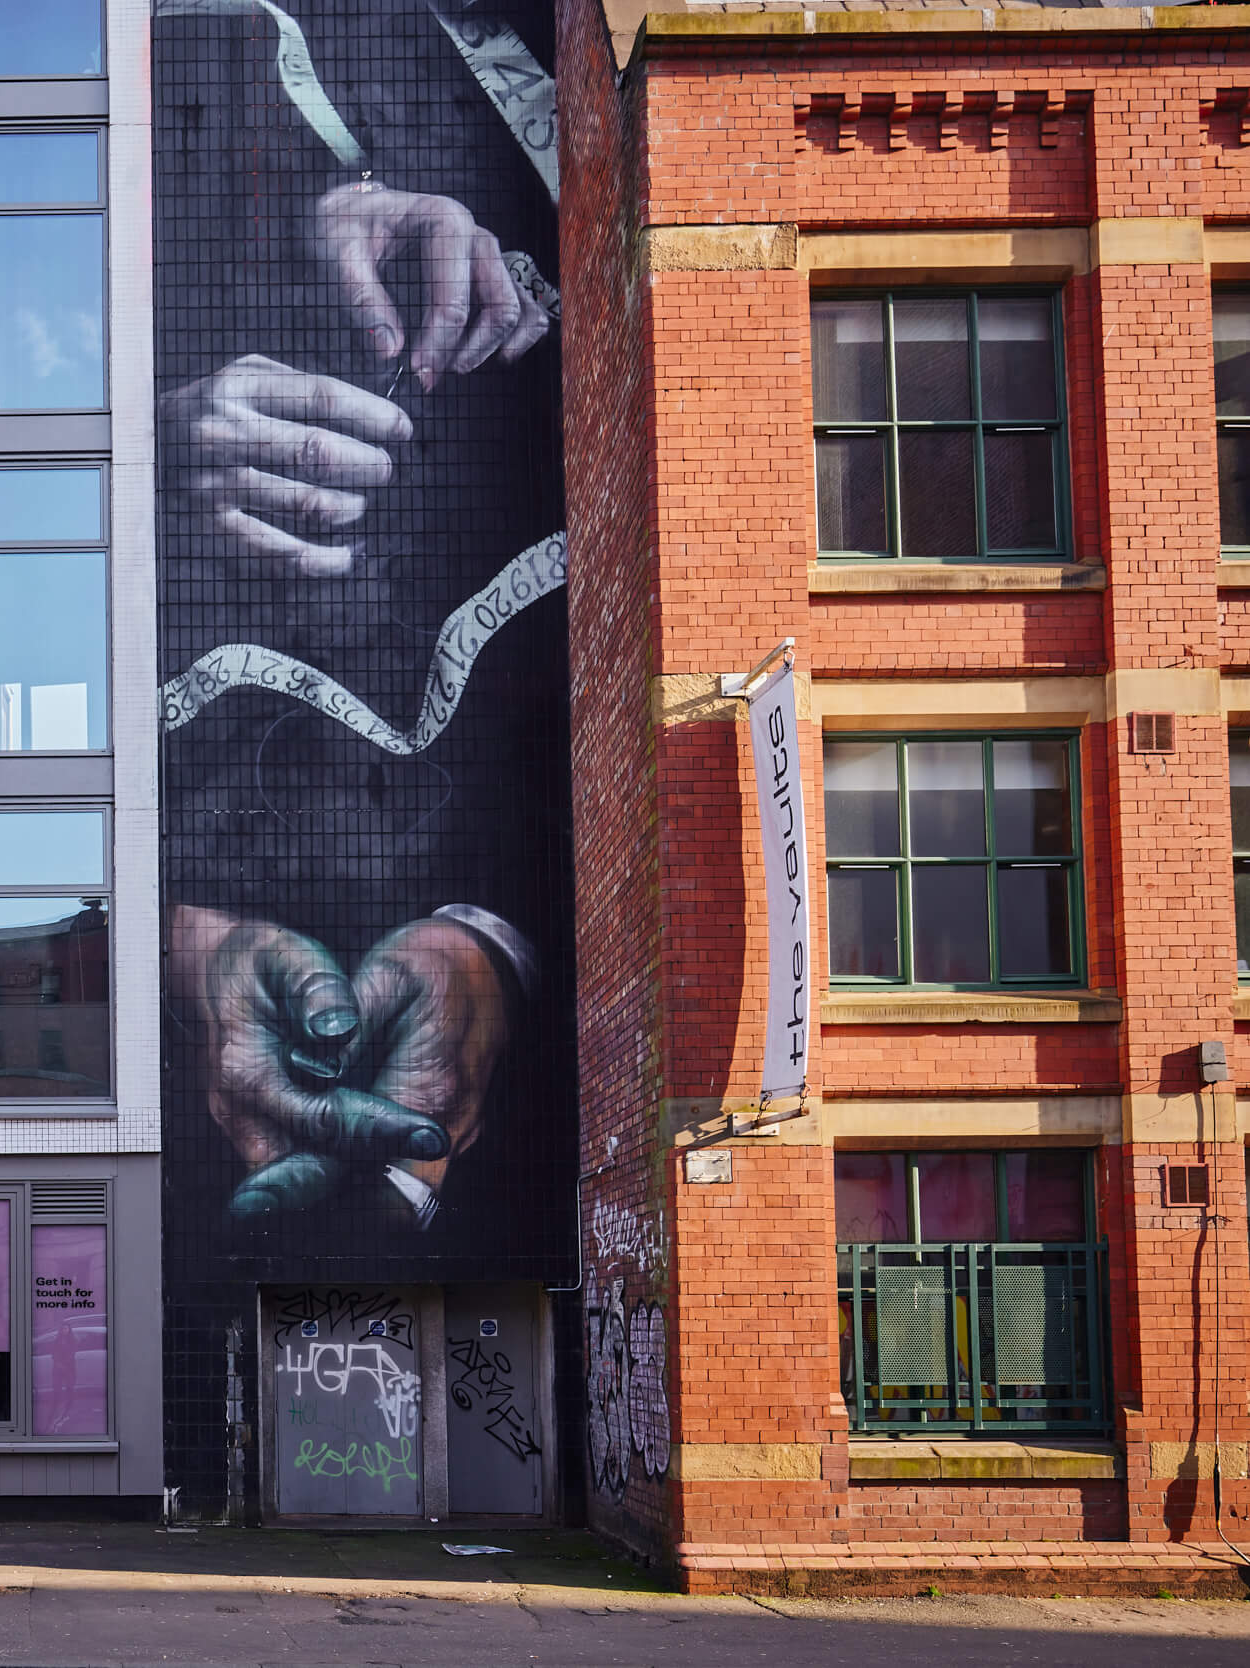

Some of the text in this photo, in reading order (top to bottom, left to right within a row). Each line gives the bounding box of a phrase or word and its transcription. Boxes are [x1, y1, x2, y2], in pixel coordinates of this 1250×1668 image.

[510, 556, 546, 600] 19
[475, 586, 512, 630] 20
[437, 616, 477, 671] 21
[196, 656, 231, 696] 28
[241, 651, 283, 687] 27
[285, 666, 323, 702] 26
[326, 692, 362, 726] 25
[426, 672, 457, 725] 22
[768, 704, 805, 1066] the vaults
[36, 1277, 72, 1286] Get in
[36, 1288, 94, 1298] touch for
[36, 1299, 95, 1309] more info
